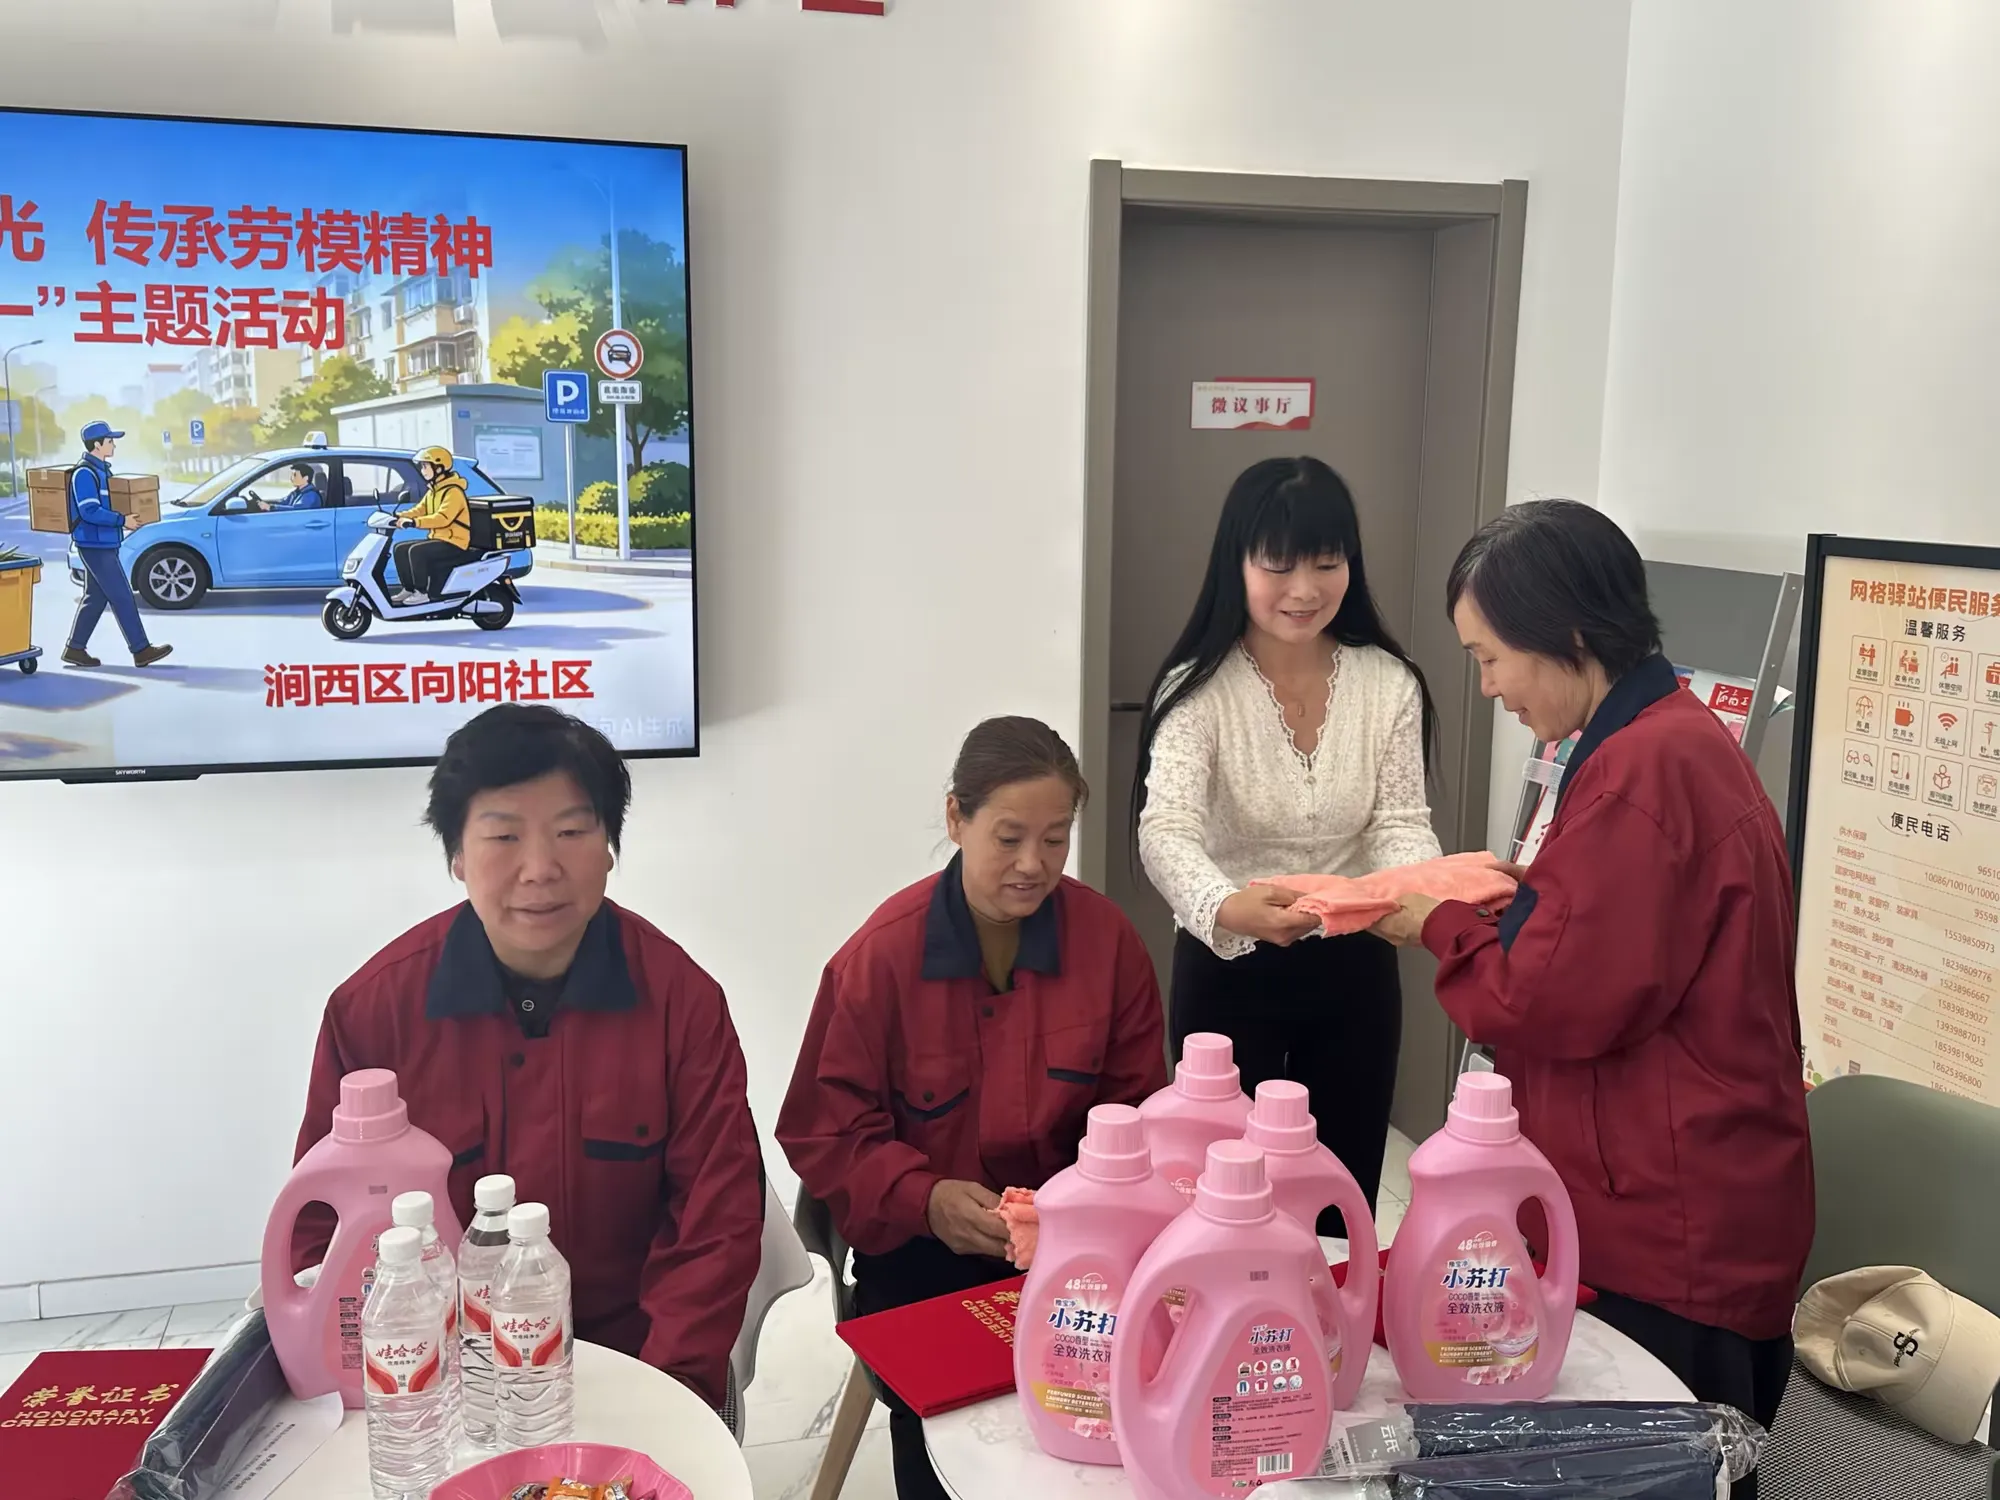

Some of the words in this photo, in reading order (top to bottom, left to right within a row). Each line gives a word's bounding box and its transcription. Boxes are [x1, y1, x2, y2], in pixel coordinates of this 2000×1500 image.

[86, 198, 493, 279] 传承劳模精神
[556, 380, 579, 405] P
[1211, 397, 1291, 414] 微议事厅
[1904, 619, 1966, 642] 温馨服务
[263, 659, 594, 707] 涧西区向阳社区
[1892, 728, 1915, 738] 饮用水
[1934, 736, 1959, 748] 无线上网
[1891, 811, 1951, 842] 便民电话
[1925, 872, 1999, 902] 10086/10010/10000
[1974, 908, 1998, 924] 95598
[1944, 928, 1995, 954] 15539850973
[1941, 957, 1993, 983] 18239809776
[1940, 978, 1990, 1004] 15238966667
[1938, 999, 1988, 1025] 15839839027
[1936, 1019, 1986, 1046] 13939887013
[1932, 1060, 1982, 1089] 18625396800
[1458, 1239, 1473, 1251] 48
[1064, 1278, 1081, 1290] 48
[1443, 1268, 1510, 1288] 小苏打
[1447, 1302, 1506, 1315] 全效洗衣液
[502, 1318, 549, 1333] 娃哈哈
[961, 1299, 1014, 1348] CREDENT
[1049, 1308, 1117, 1336] 小苏打
[1250, 1328, 1293, 1345] 小苏打
[376, 1343, 427, 1359] 娃哈哈
[22, 1383, 180, 1408] 荣誉证书
[0, 1416, 154, 1428] CREDENTIAL
[15, 1408, 155, 1419] HONORARY
